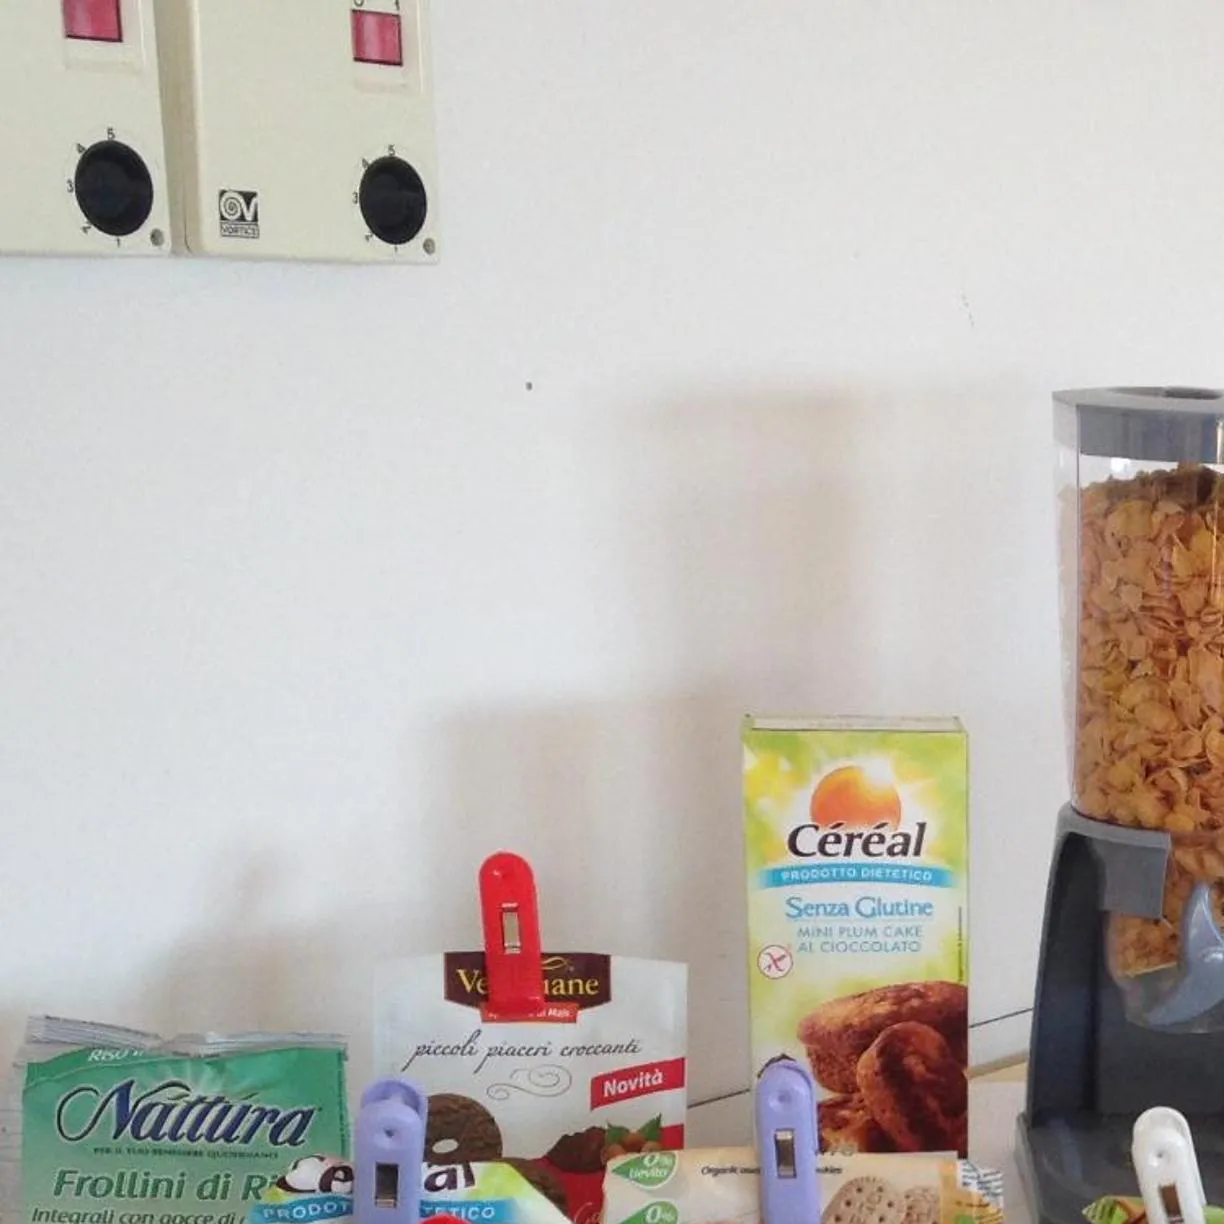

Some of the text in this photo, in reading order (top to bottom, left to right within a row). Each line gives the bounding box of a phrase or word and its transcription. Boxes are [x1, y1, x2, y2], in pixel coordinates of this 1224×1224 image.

[787, 821, 927, 858] Céréal
[781, 866, 933, 882] PRODOTTO DIETETICO
[785, 896, 934, 919] Senza Glutine
[797, 925, 923, 938] MINI PLUM CAKE
[797, 940, 922, 953] AL CIOCCOLATO
[401, 1028, 642, 1075] piccoli piaceri croccanti
[602, 1067, 664, 1098] Novità
[53, 1169, 187, 1200] Frollini
[195, 1172, 232, 1201] di
[118, 1212, 154, 1224] con
